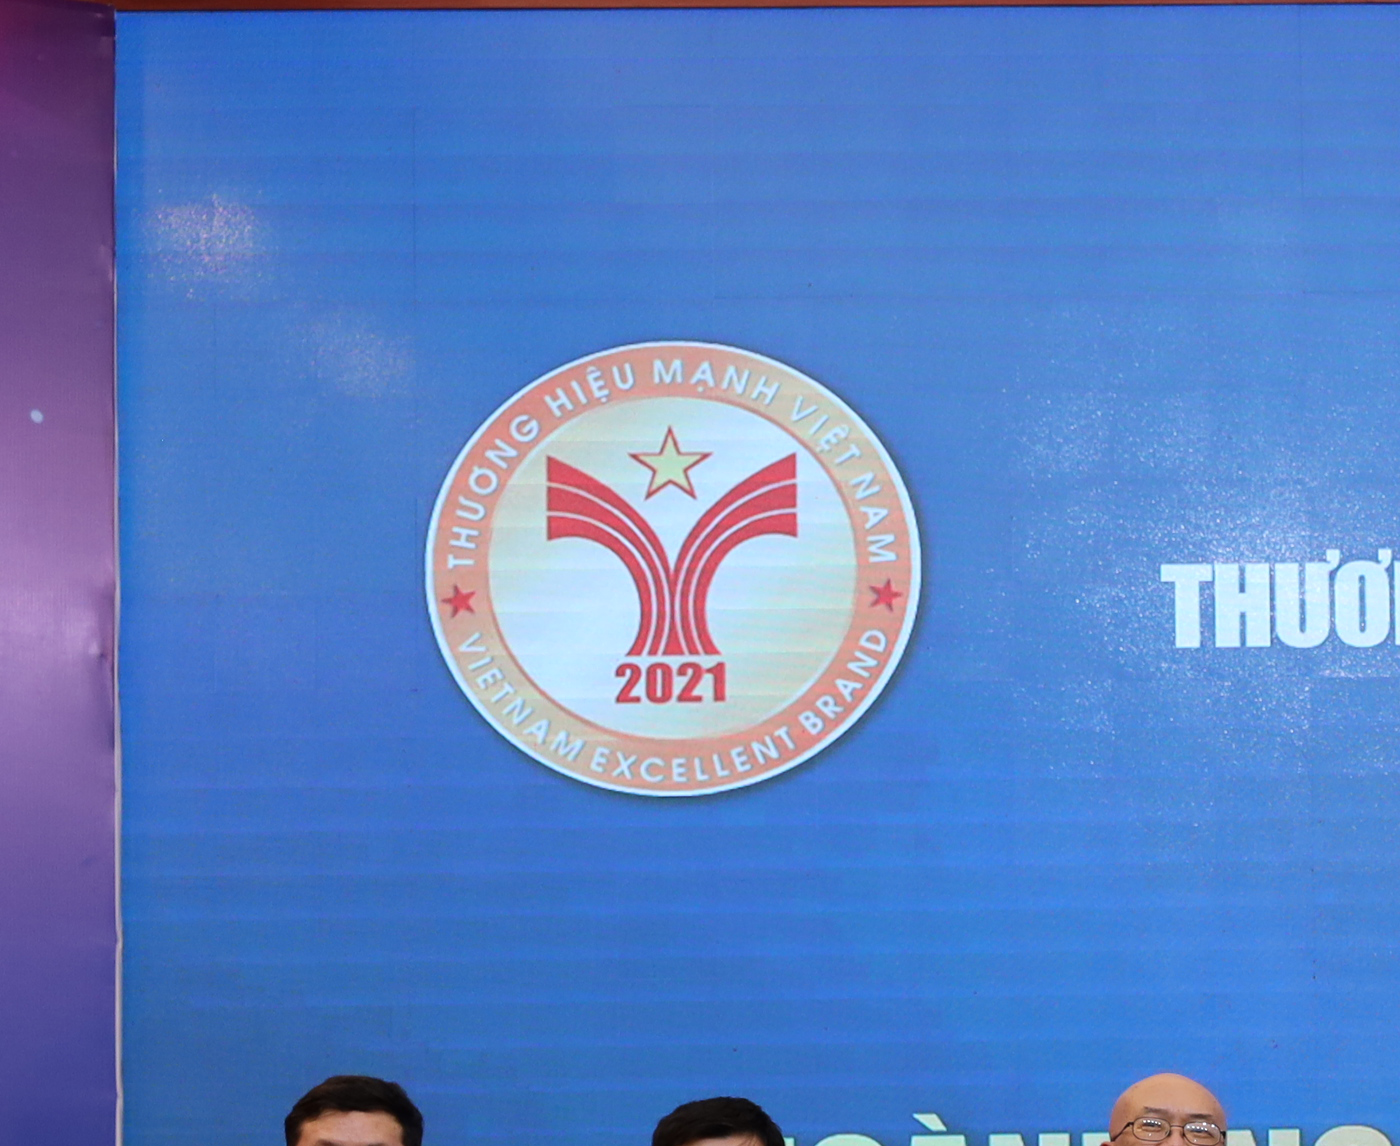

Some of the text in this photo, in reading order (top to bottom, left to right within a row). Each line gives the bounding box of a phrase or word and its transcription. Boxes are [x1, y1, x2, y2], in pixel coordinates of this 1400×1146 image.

[447, 358, 897, 570] THƯƠNG HIỆU MẠNH VIỆT NAM
[457, 626, 889, 784] VIETNAM EXCELLENT BRAND
[614, 661, 728, 704] 2021
